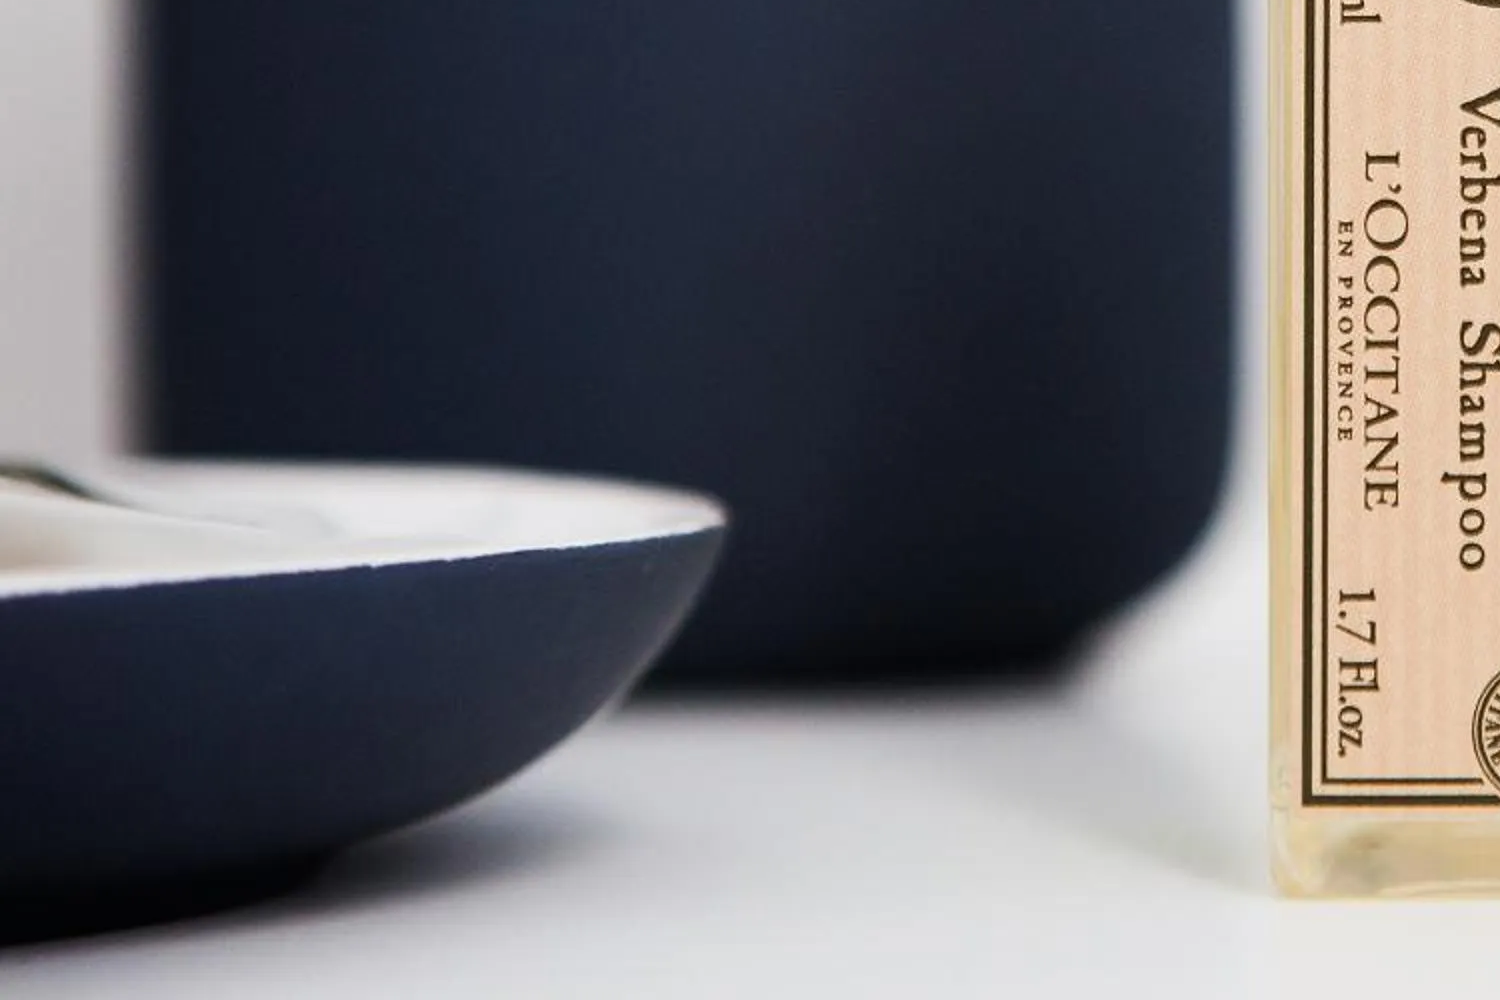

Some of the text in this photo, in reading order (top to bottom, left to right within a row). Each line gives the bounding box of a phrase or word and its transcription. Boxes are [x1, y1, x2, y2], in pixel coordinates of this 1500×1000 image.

[1337, 221, 1354, 441] EN PROVENCE
[1363, 150, 1409, 512] L'OCCITANE
[1335, 588, 1377, 646] 1.7
